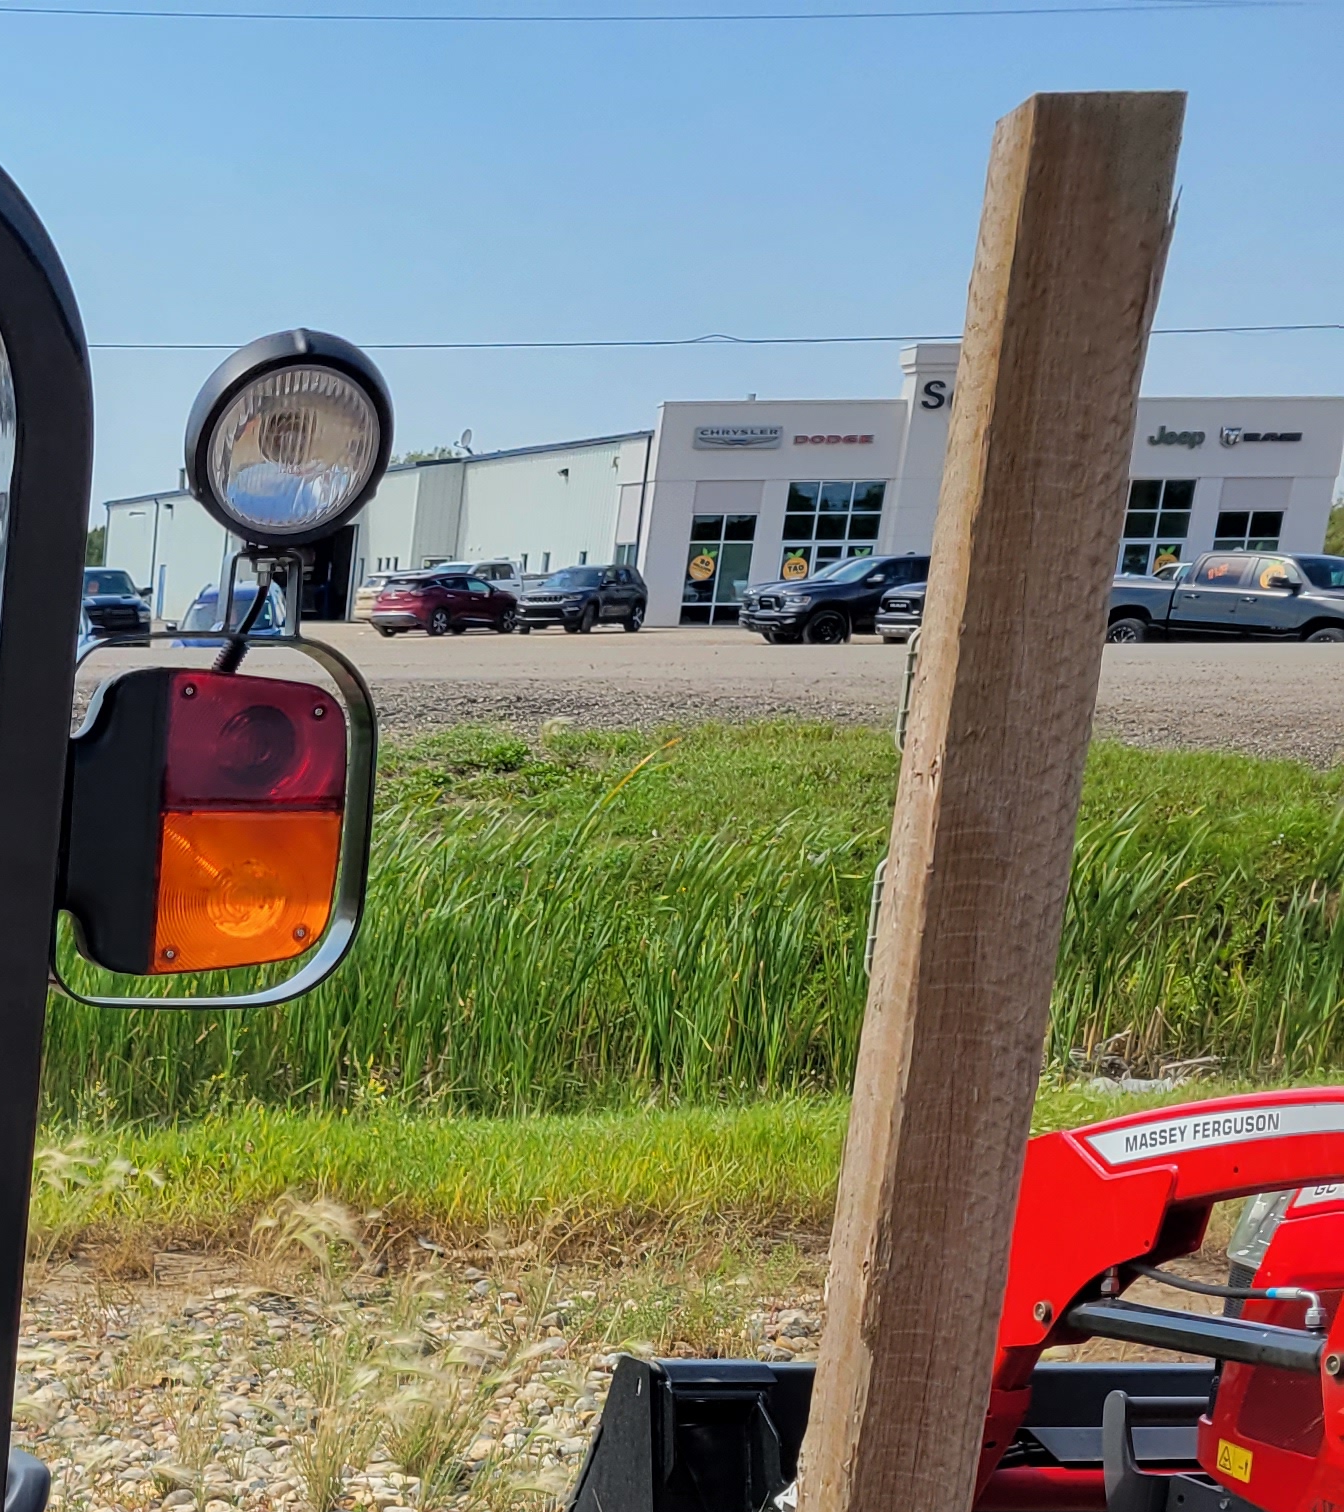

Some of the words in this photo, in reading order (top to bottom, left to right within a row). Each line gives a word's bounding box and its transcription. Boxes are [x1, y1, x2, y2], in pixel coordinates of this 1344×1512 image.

[921, 380, 954, 409] S
[793, 434, 875, 445] DODGE
[1147, 425, 1206, 450] Jeep
[1125, 1125, 1188, 1152] MASSEY
[1193, 1112, 1280, 1140] FERGUSON
